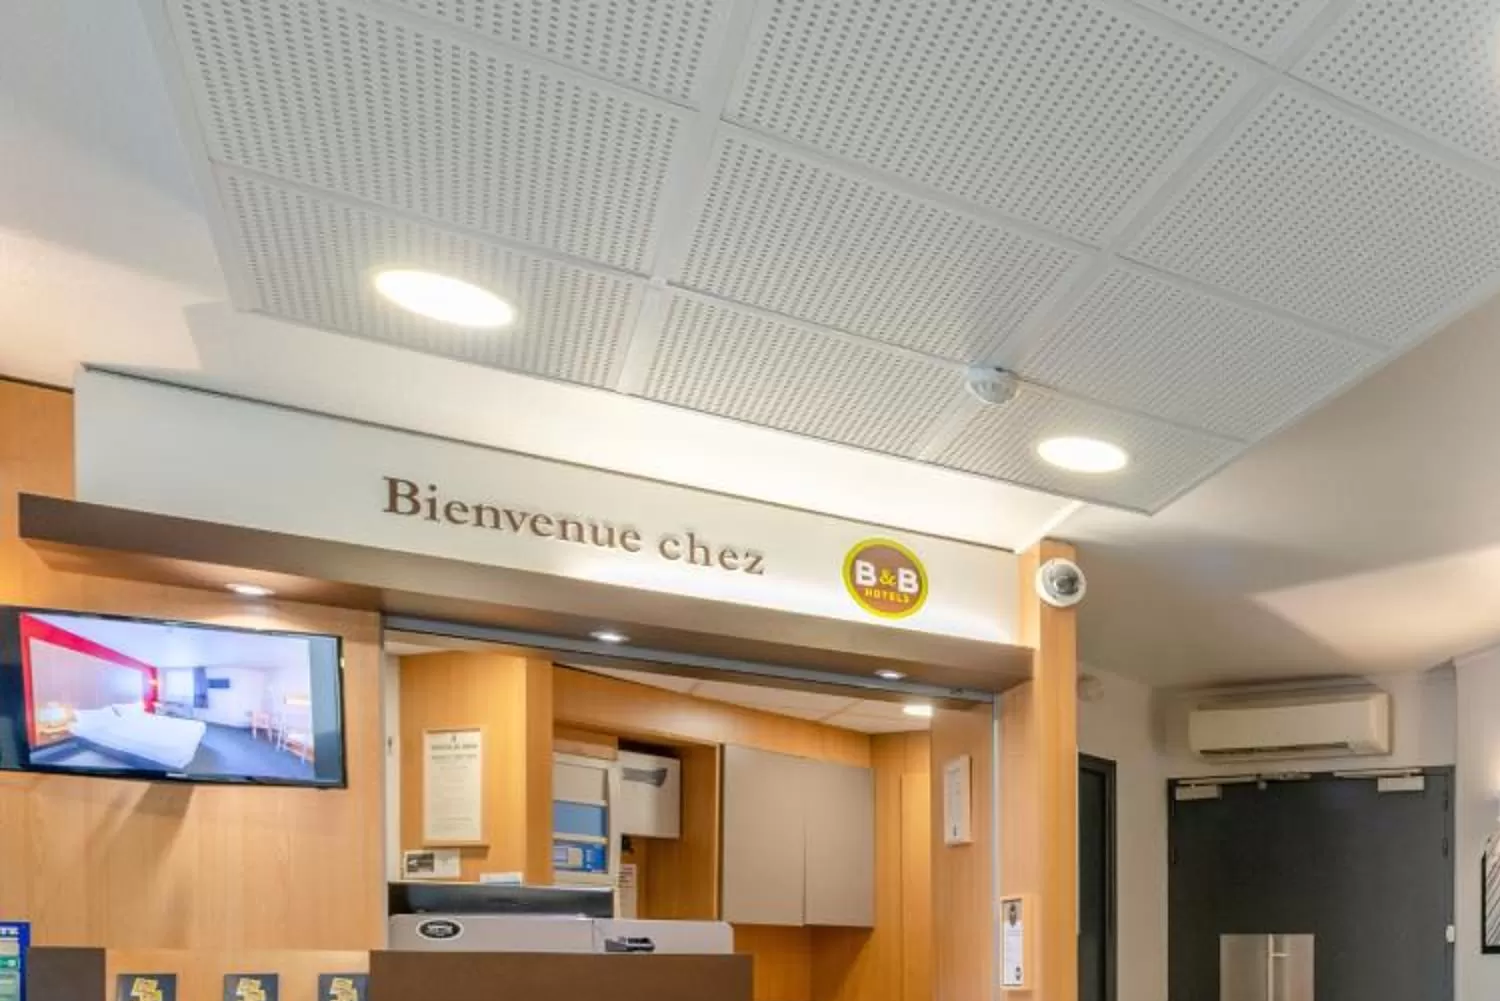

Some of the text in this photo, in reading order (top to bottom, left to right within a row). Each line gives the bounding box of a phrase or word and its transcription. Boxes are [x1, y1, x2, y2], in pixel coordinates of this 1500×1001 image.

[381, 475, 765, 576] Bienvenue chez
[855, 560, 919, 594] B&B
[865, 587, 910, 603] HOTELS
